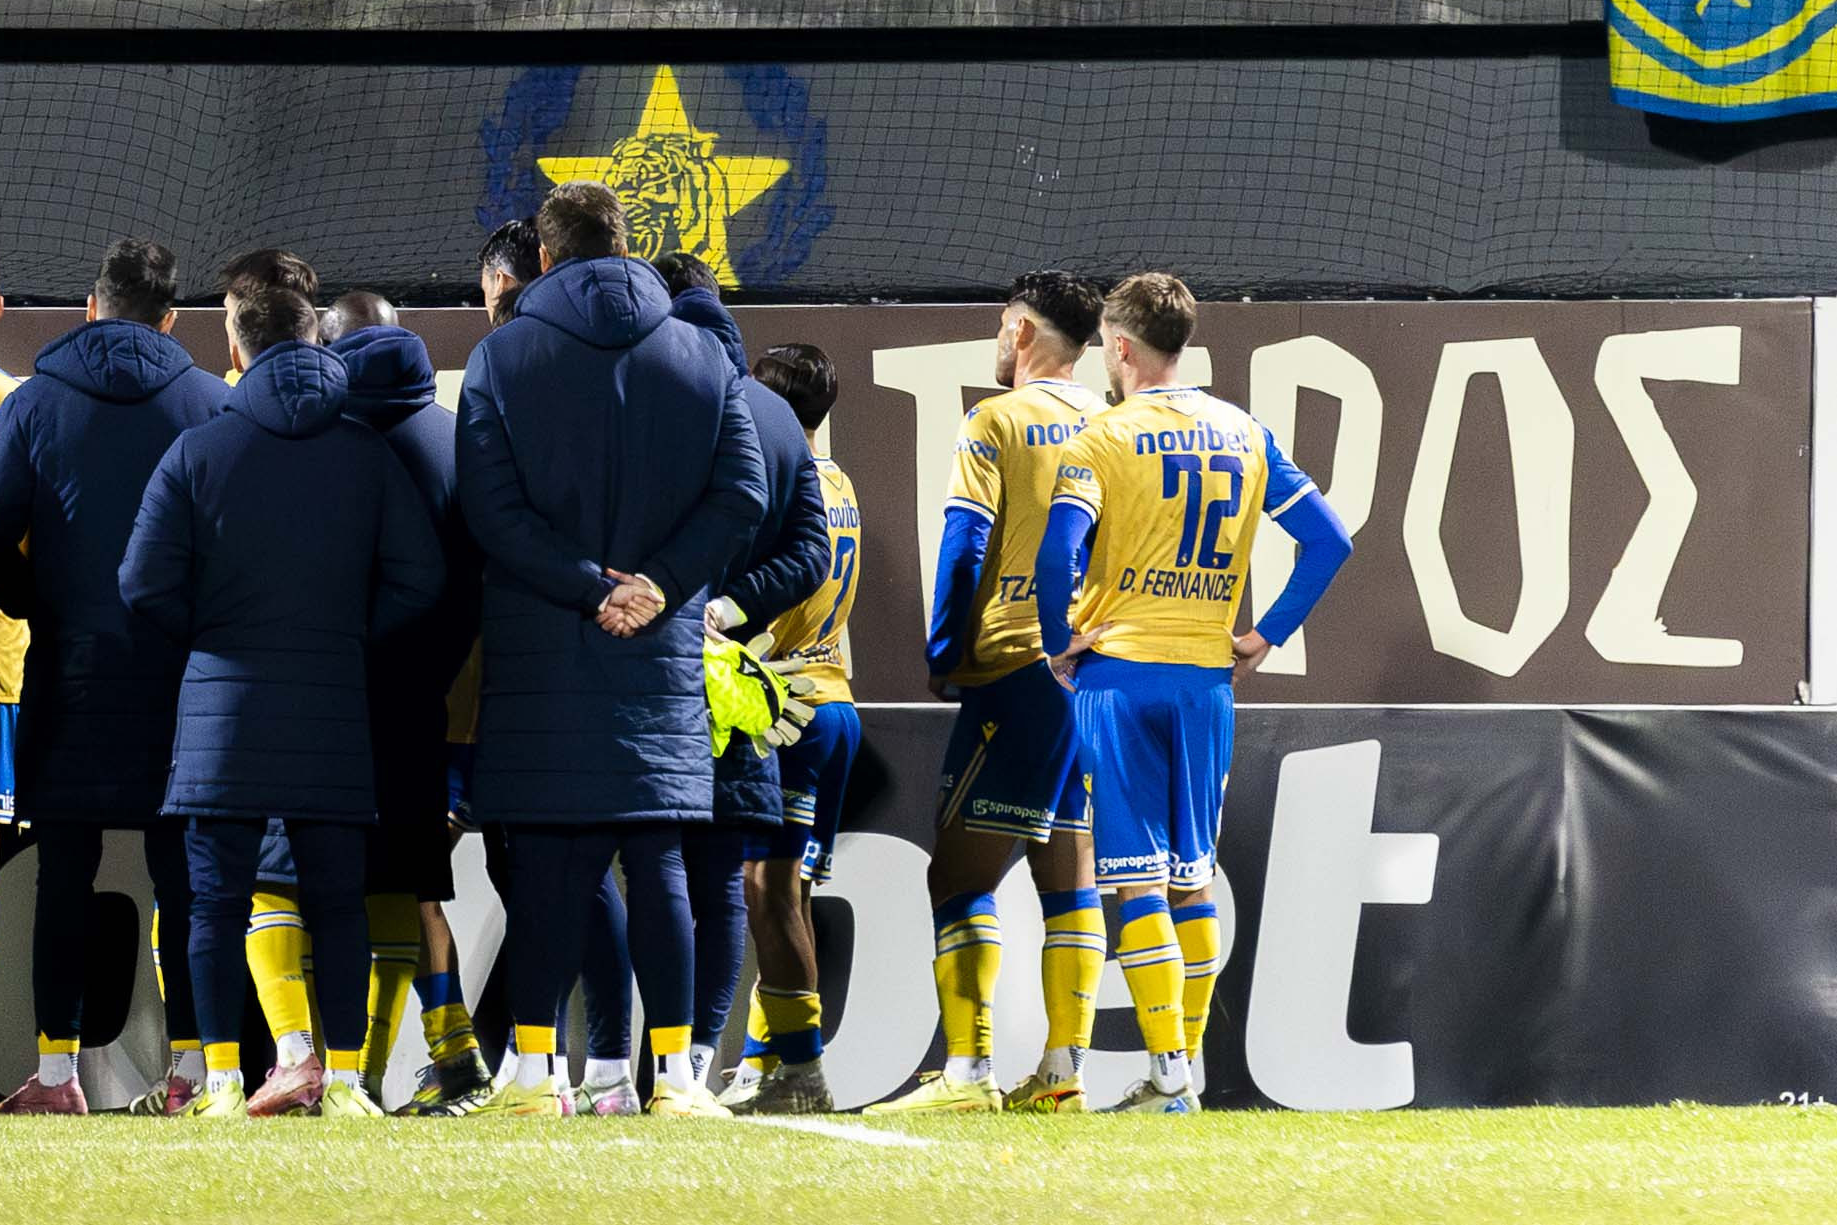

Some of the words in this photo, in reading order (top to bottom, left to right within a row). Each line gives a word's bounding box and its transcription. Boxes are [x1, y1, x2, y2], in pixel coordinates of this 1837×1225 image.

[1135, 420, 1253, 455] novibet
[1162, 454, 1245, 570] 72
[1118, 567, 1137, 593] D.
